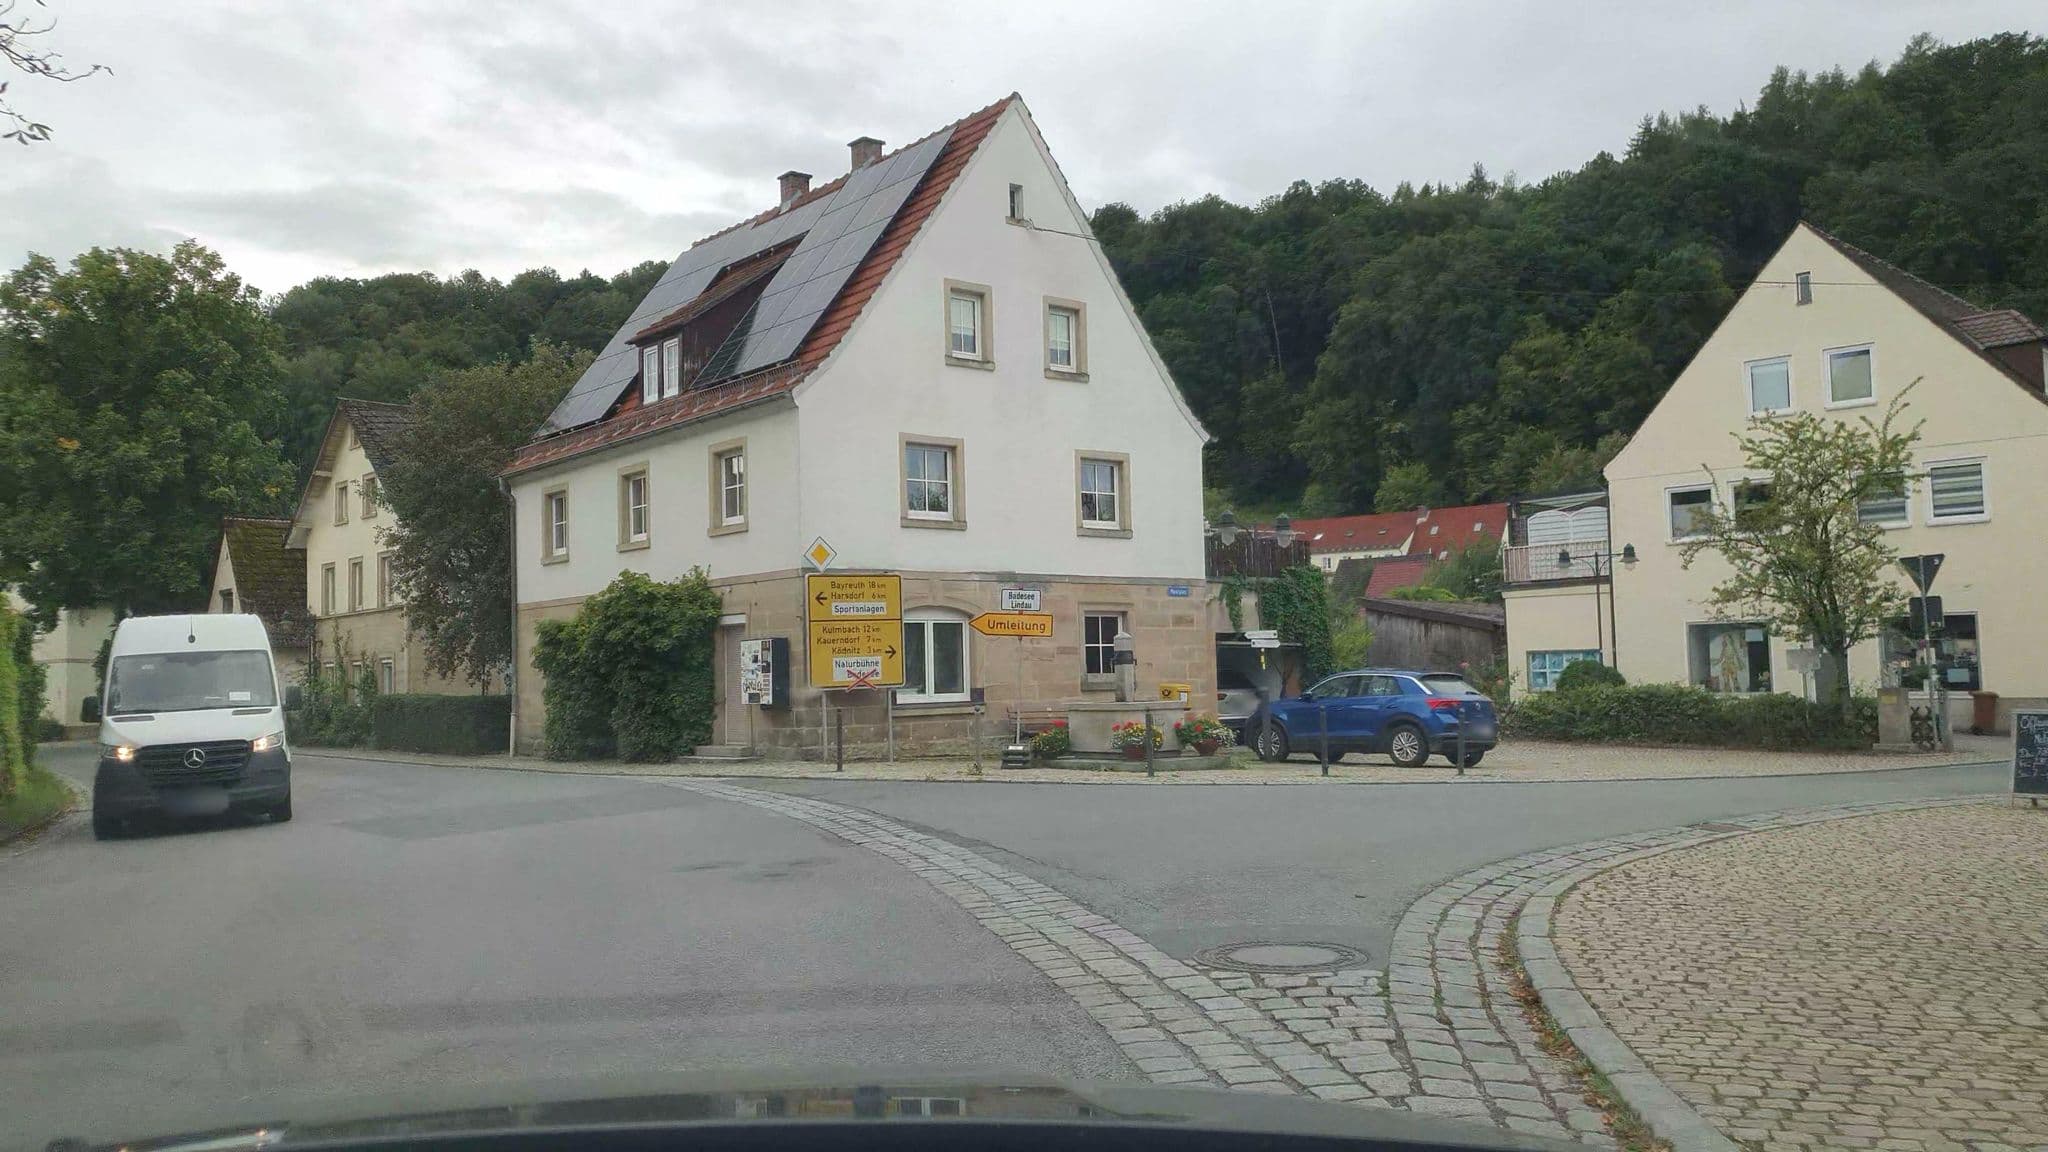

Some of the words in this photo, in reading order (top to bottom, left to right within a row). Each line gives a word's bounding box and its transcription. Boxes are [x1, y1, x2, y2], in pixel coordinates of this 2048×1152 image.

[831, 581, 865, 590] Bayreuth
[831, 592, 865, 600] Harsdorf
[1008, 591, 1035, 600] Badesee
[834, 605, 885, 614] Sportanlagen
[1011, 601, 1032, 609] Lindau
[822, 625, 860, 633] Kulmbach
[988, 619, 1046, 633] Umleitung
[817, 636, 860, 645] Kauerndorf
[835, 659, 880, 668] Naturbühne
